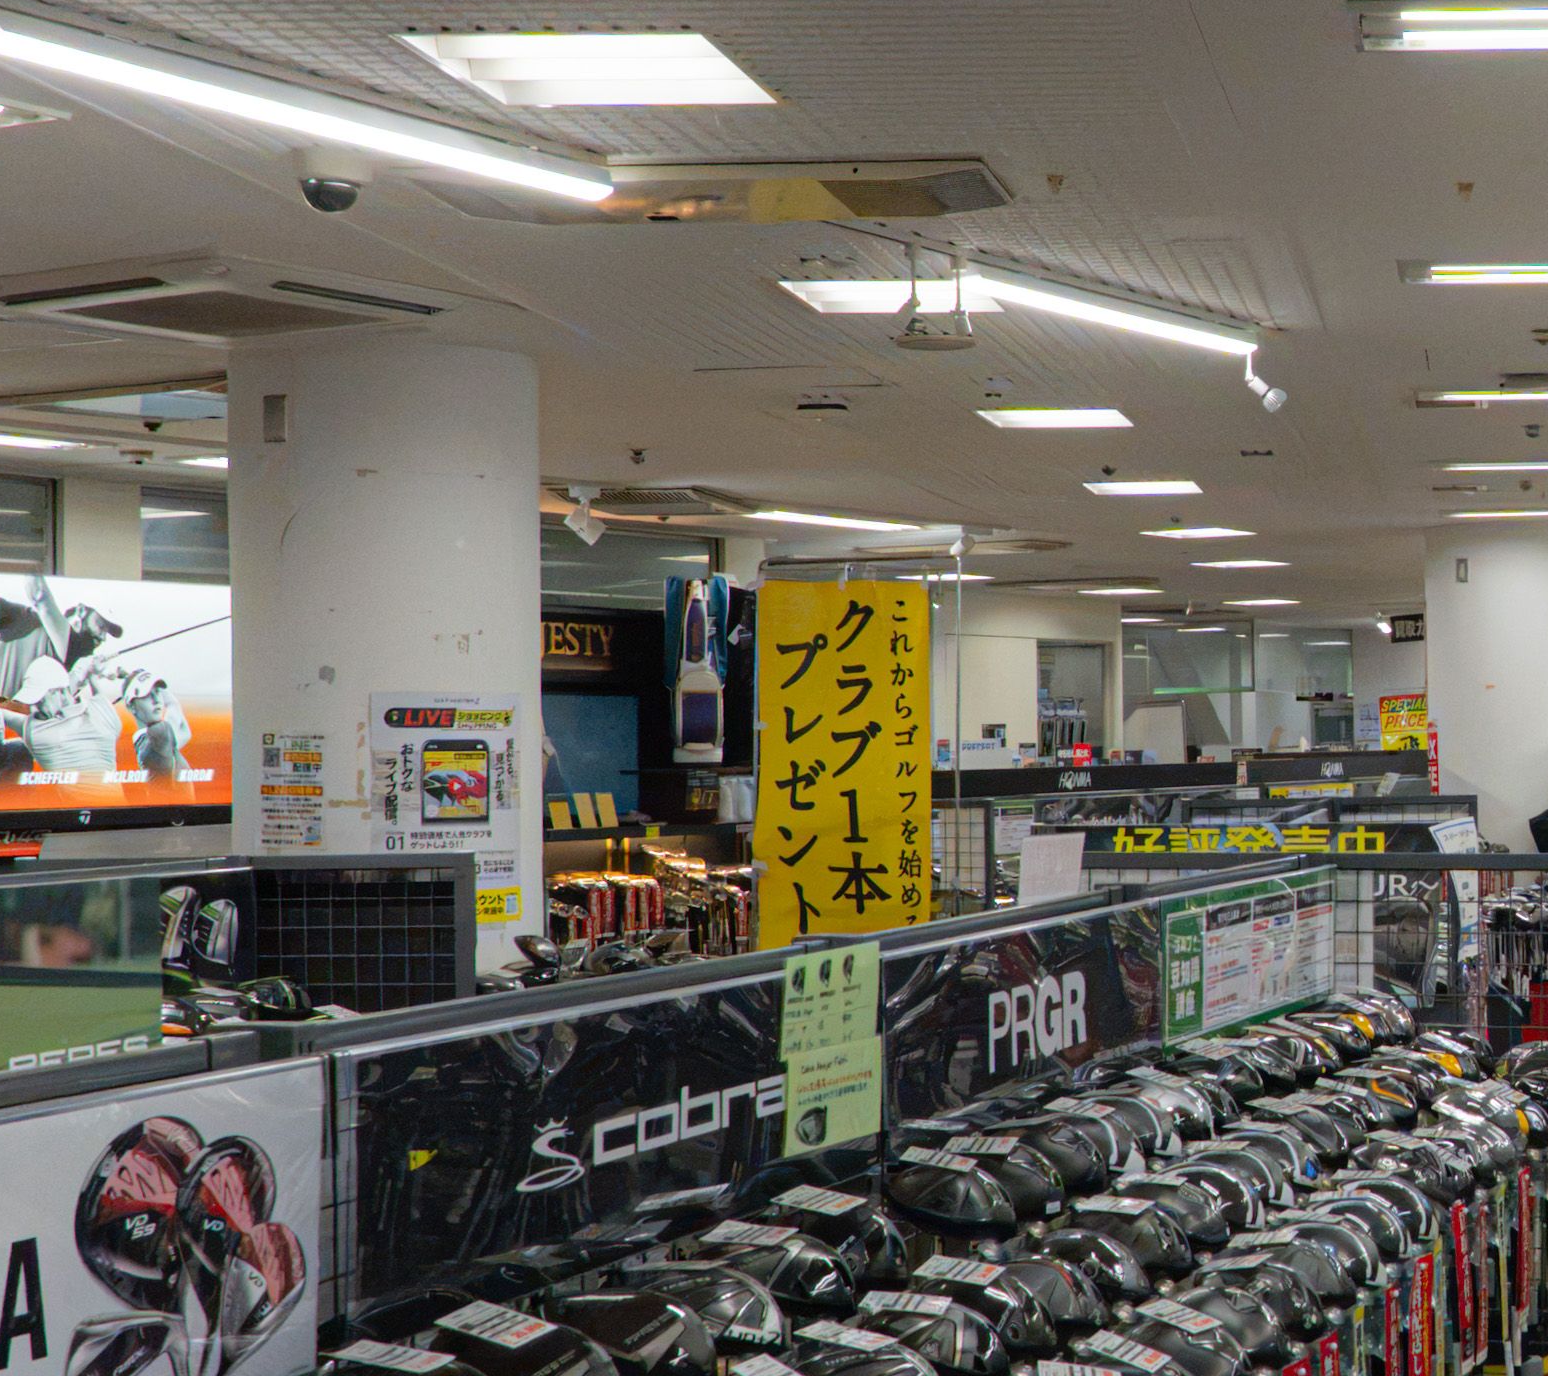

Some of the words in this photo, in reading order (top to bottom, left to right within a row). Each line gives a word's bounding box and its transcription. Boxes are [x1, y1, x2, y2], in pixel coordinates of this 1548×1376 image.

[403, 708, 455, 727] LIVE
[1380, 696, 1428, 713] SPECIAL
[1385, 713, 1428, 730] PRICE
[400, 742, 414, 793] おトクな
[829, 599, 889, 917] クラブ1本
[889, 599, 920, 922] これからゴルフを始め
[18, 771, 79, 785] SCHEFFLER
[178, 768, 214, 782] KORDA
[775, 634, 825, 934] プレゼント
[386, 835, 405, 851] 01
[1112, 825, 1386, 854] 好評発売中
[987, 970, 1087, 1076] PRGR
[590, 1074, 786, 1166] cobra
